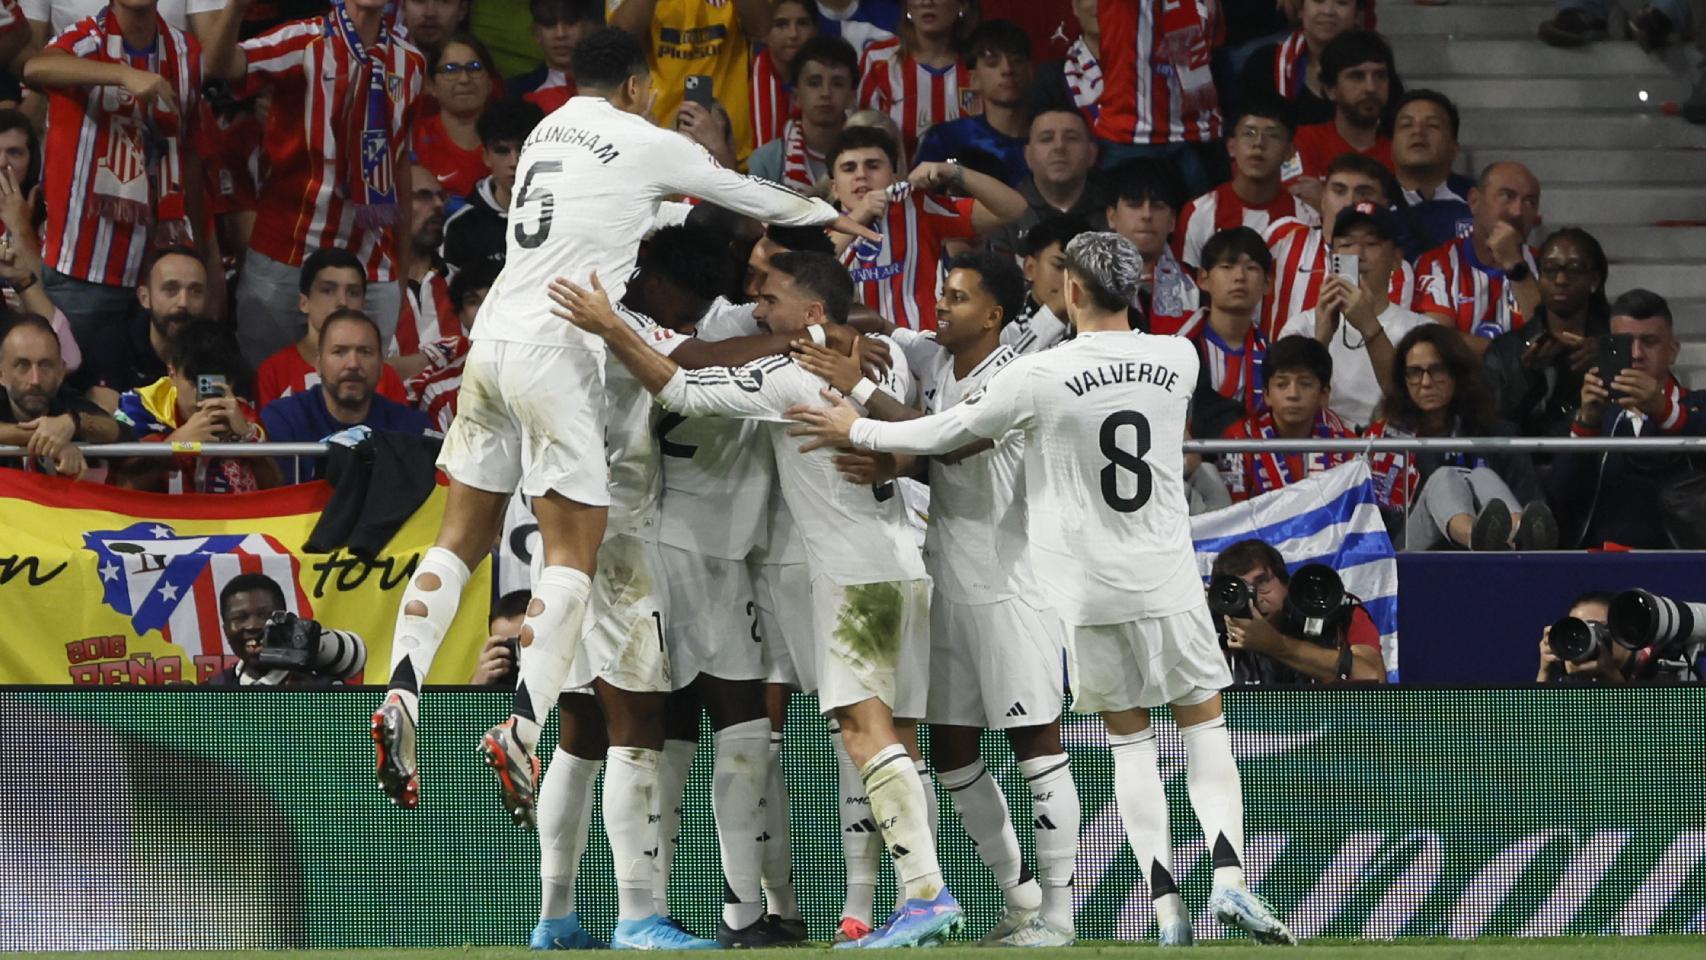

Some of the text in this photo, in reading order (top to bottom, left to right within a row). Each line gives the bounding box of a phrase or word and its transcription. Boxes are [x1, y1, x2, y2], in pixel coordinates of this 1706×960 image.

[514, 160, 563, 249] 5
[1065, 362, 1179, 397] VALVERDE
[1100, 410, 1152, 513] 8
